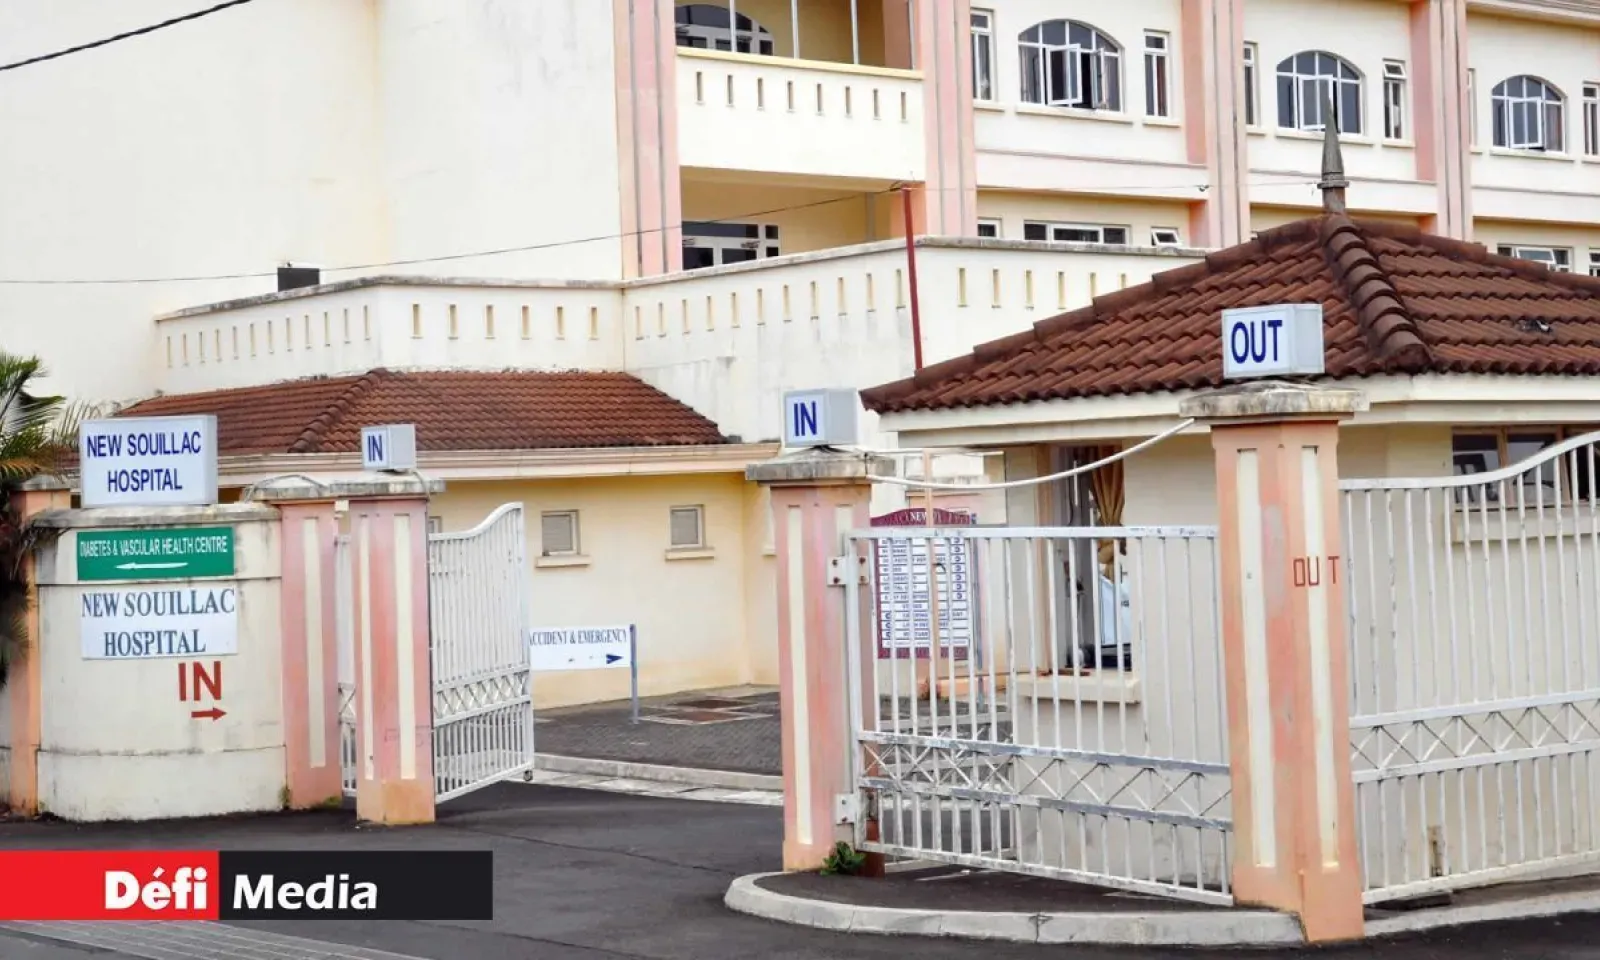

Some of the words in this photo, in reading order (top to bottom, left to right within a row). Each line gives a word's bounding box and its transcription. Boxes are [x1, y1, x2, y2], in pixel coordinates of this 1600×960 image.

[1231, 319, 1283, 364] OUT
[793, 400, 818, 437] IN
[86, 434, 122, 458] NEW
[127, 431, 202, 457] SOUILLAC
[367, 434, 383, 462] IN
[107, 468, 183, 493] HOSPITAL
[80, 539, 112, 557] DIABETES
[113, 538, 119, 556] &
[120, 537, 160, 557] VASCULAR
[161, 537, 194, 555] HEALTH
[194, 535, 228, 554] CENTRE
[1293, 555, 1340, 587] OUT
[81, 592, 120, 618] NEW
[123, 588, 235, 617] SOUILLAC
[104, 628, 206, 657] HOSPITAL
[569, 629, 577, 645] &
[577, 627, 627, 645] EMERGENCY
[178, 660, 222, 702] IN
